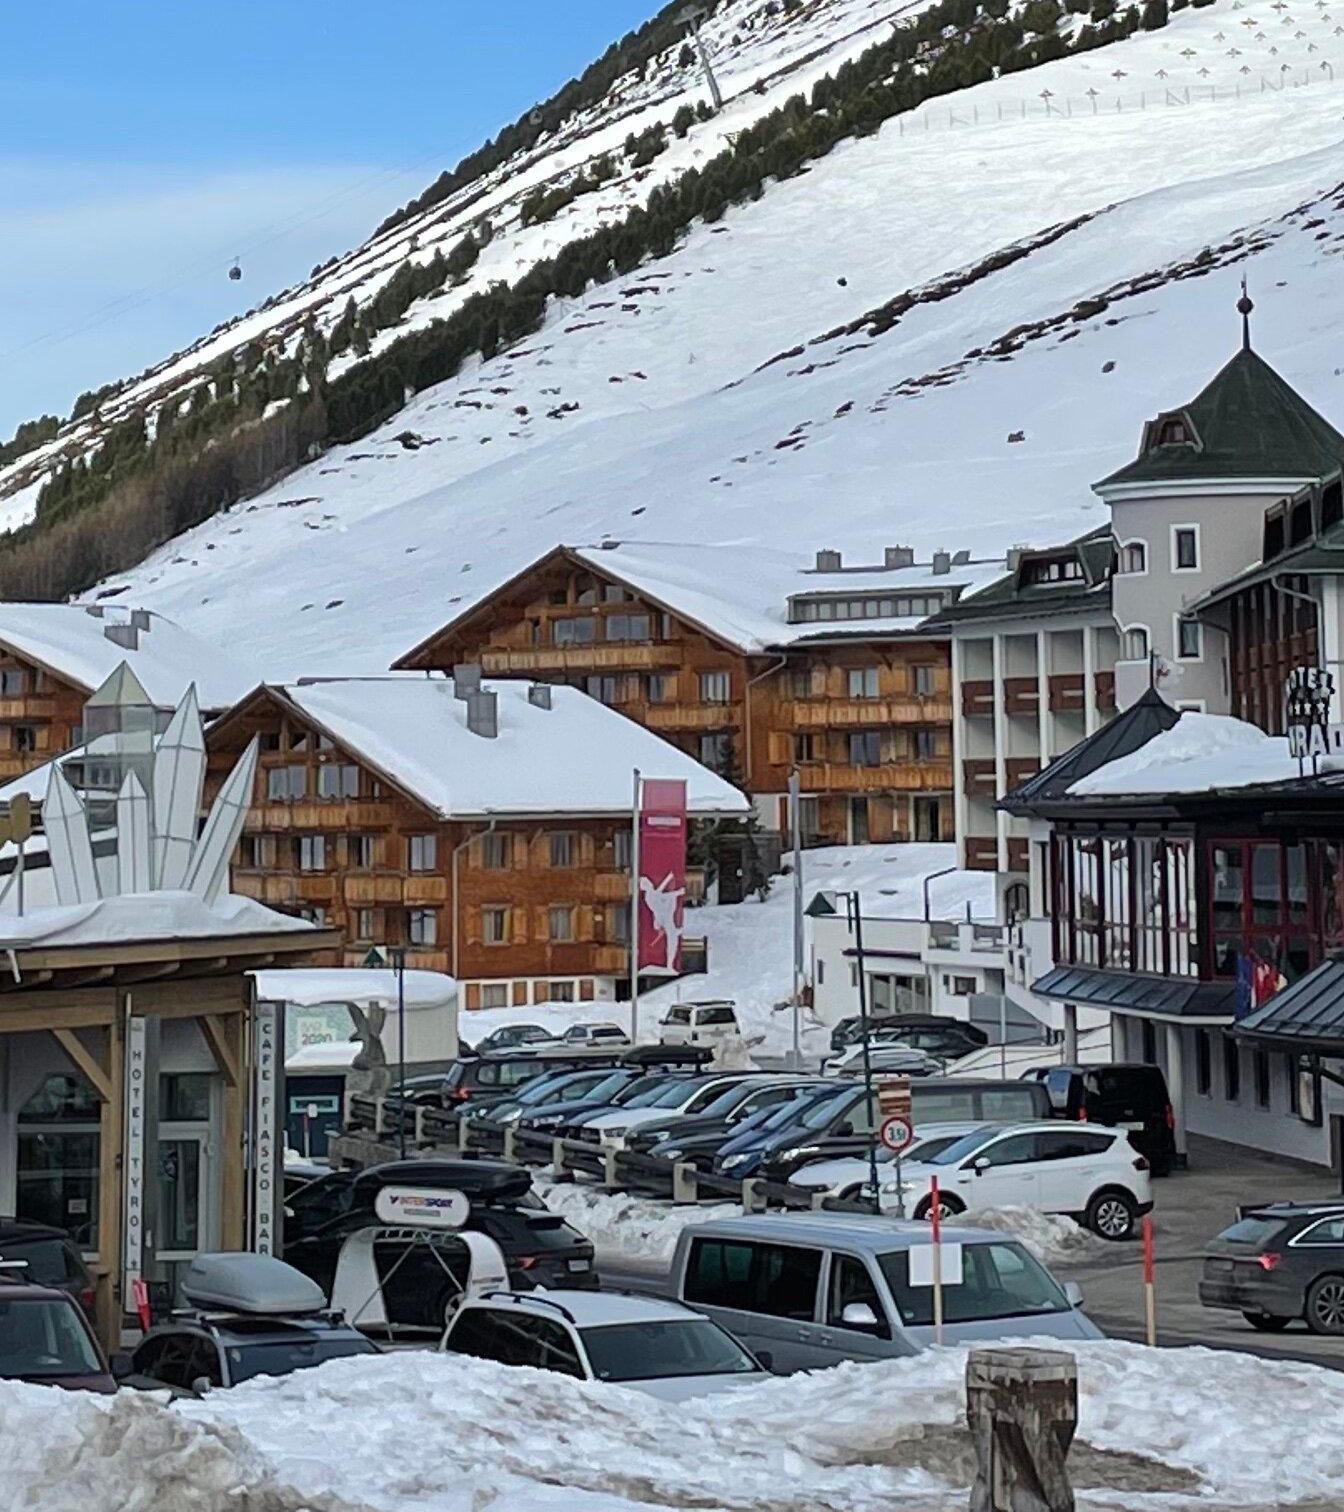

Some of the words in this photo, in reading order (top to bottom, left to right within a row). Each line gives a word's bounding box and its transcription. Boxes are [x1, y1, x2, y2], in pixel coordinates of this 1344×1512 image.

[131, 1050, 142, 1138] HOTEL
[261, 1022, 272, 1082] CAFE
[259, 1096, 272, 1191] FIASCO
[129, 1157, 140, 1247] TYROL
[258, 1213, 270, 1256] BAR
